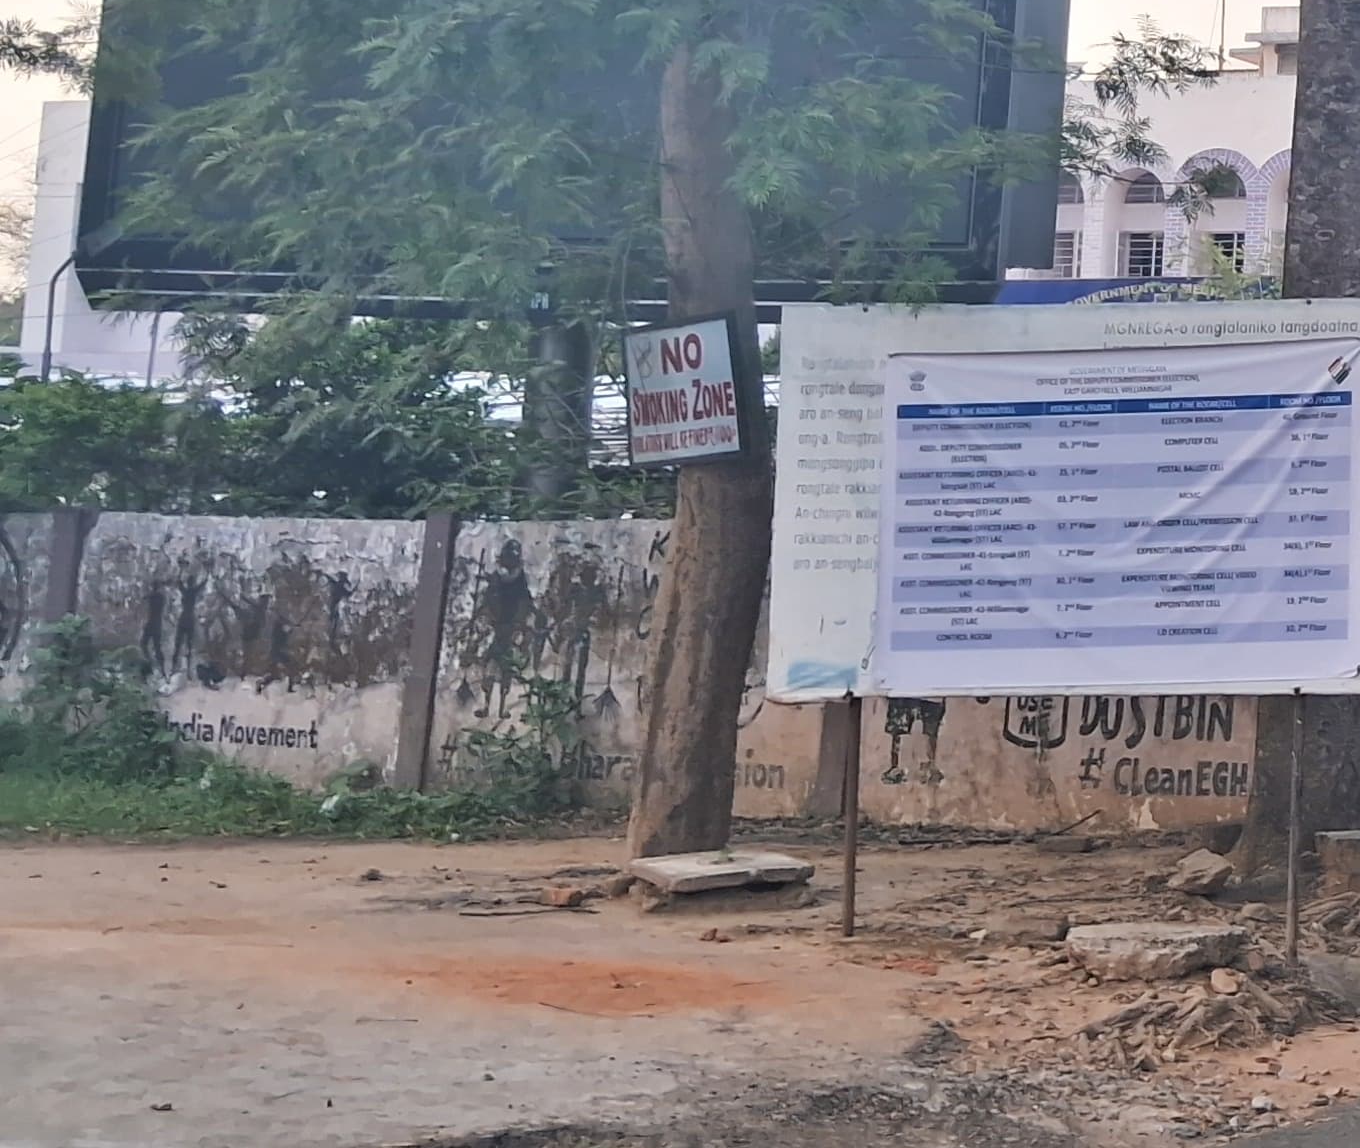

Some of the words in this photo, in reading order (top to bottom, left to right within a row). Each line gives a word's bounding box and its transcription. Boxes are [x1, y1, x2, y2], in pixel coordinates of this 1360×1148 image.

[1065, 281, 1155, 305] OVERNMENT
[660, 333, 702, 375] NO
[633, 387, 688, 427] SMOKING
[692, 379, 736, 420] ZONE
[218, 713, 319, 749] Movement
